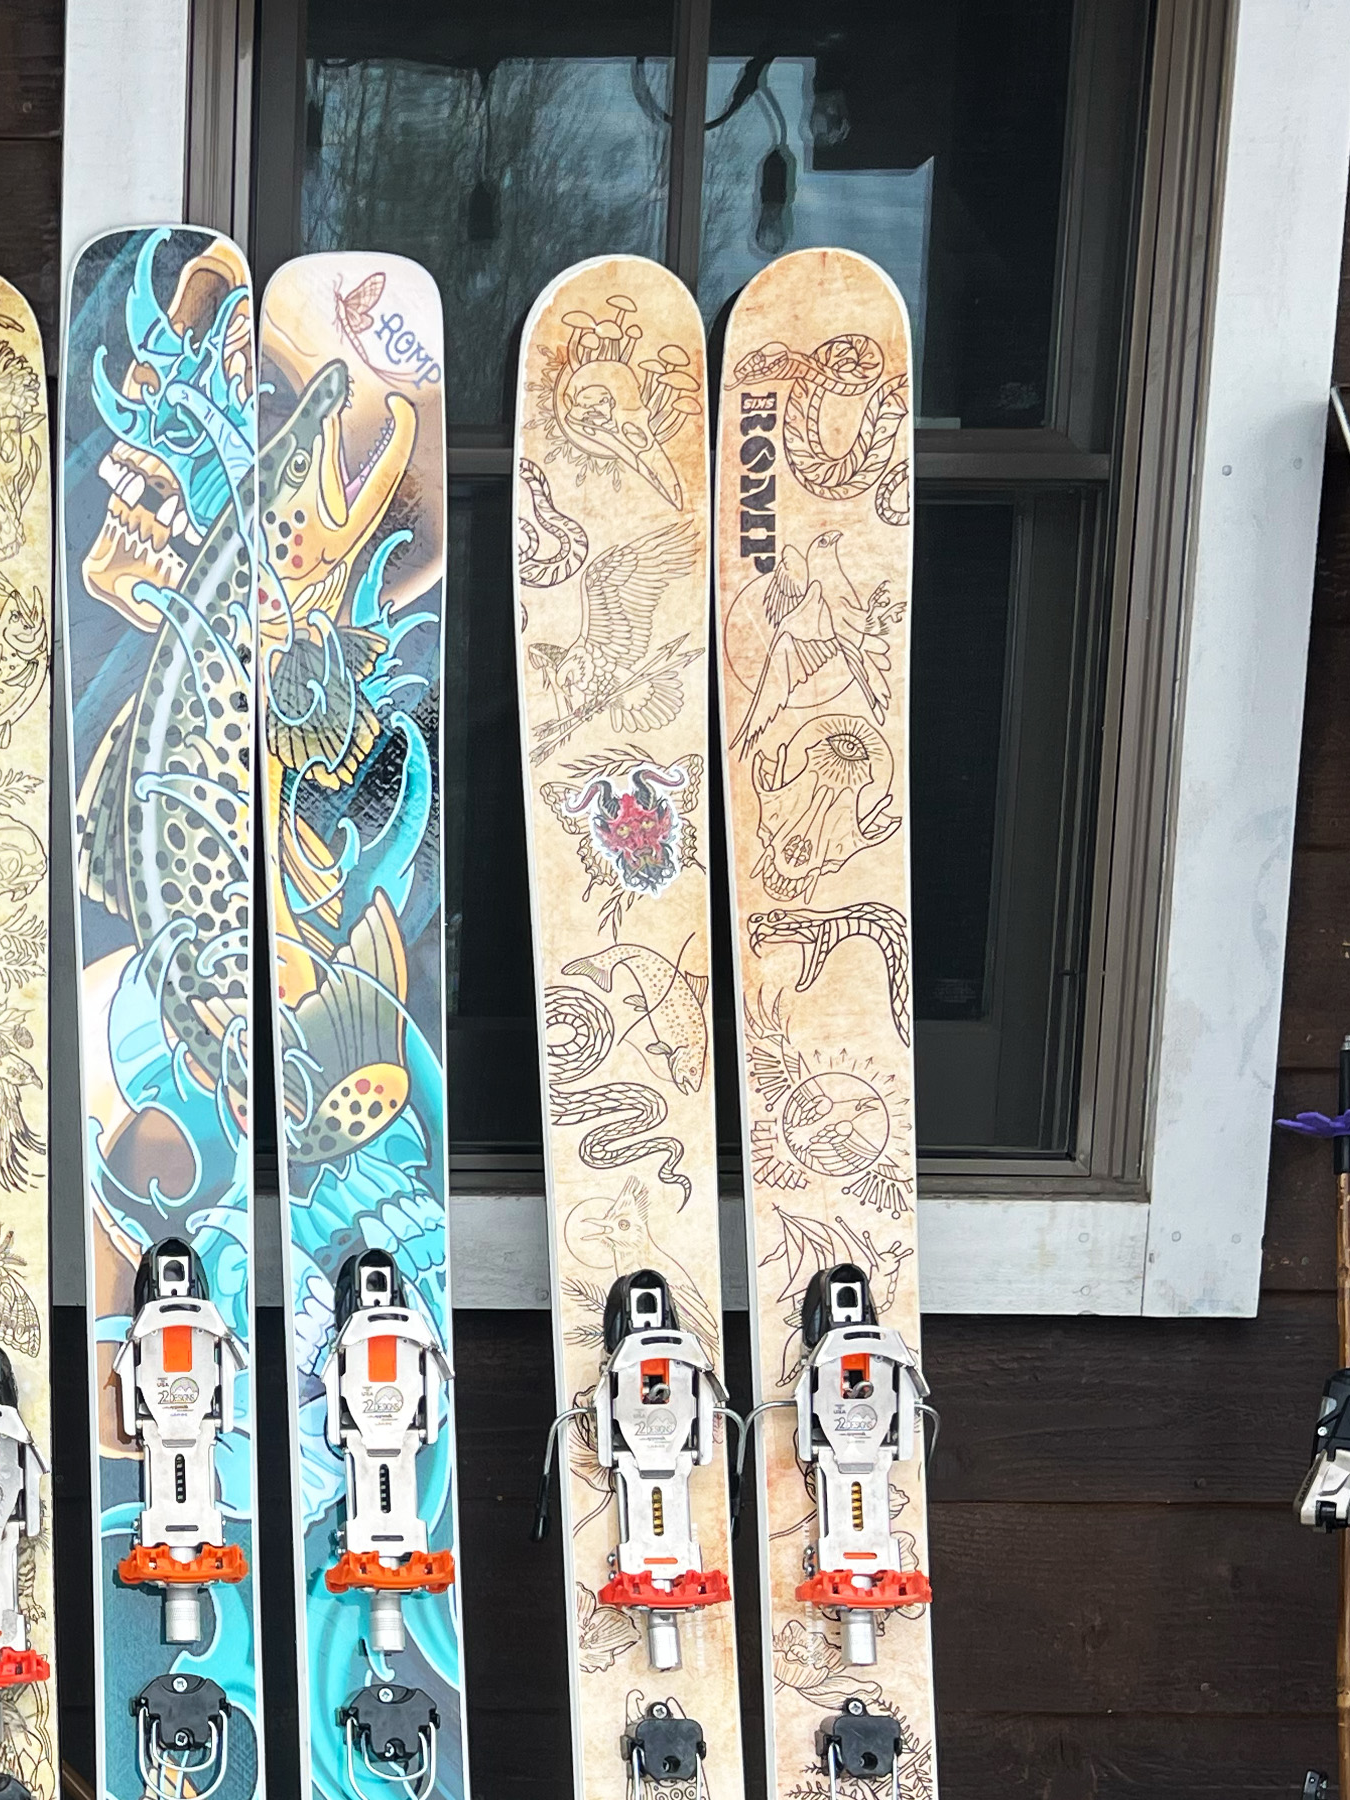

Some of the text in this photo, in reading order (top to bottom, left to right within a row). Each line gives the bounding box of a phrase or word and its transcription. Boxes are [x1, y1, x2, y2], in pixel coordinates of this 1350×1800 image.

[373, 313, 441, 390] ROMP
[743, 397, 776, 410] SKIS
[739, 391, 777, 574] ROMP
